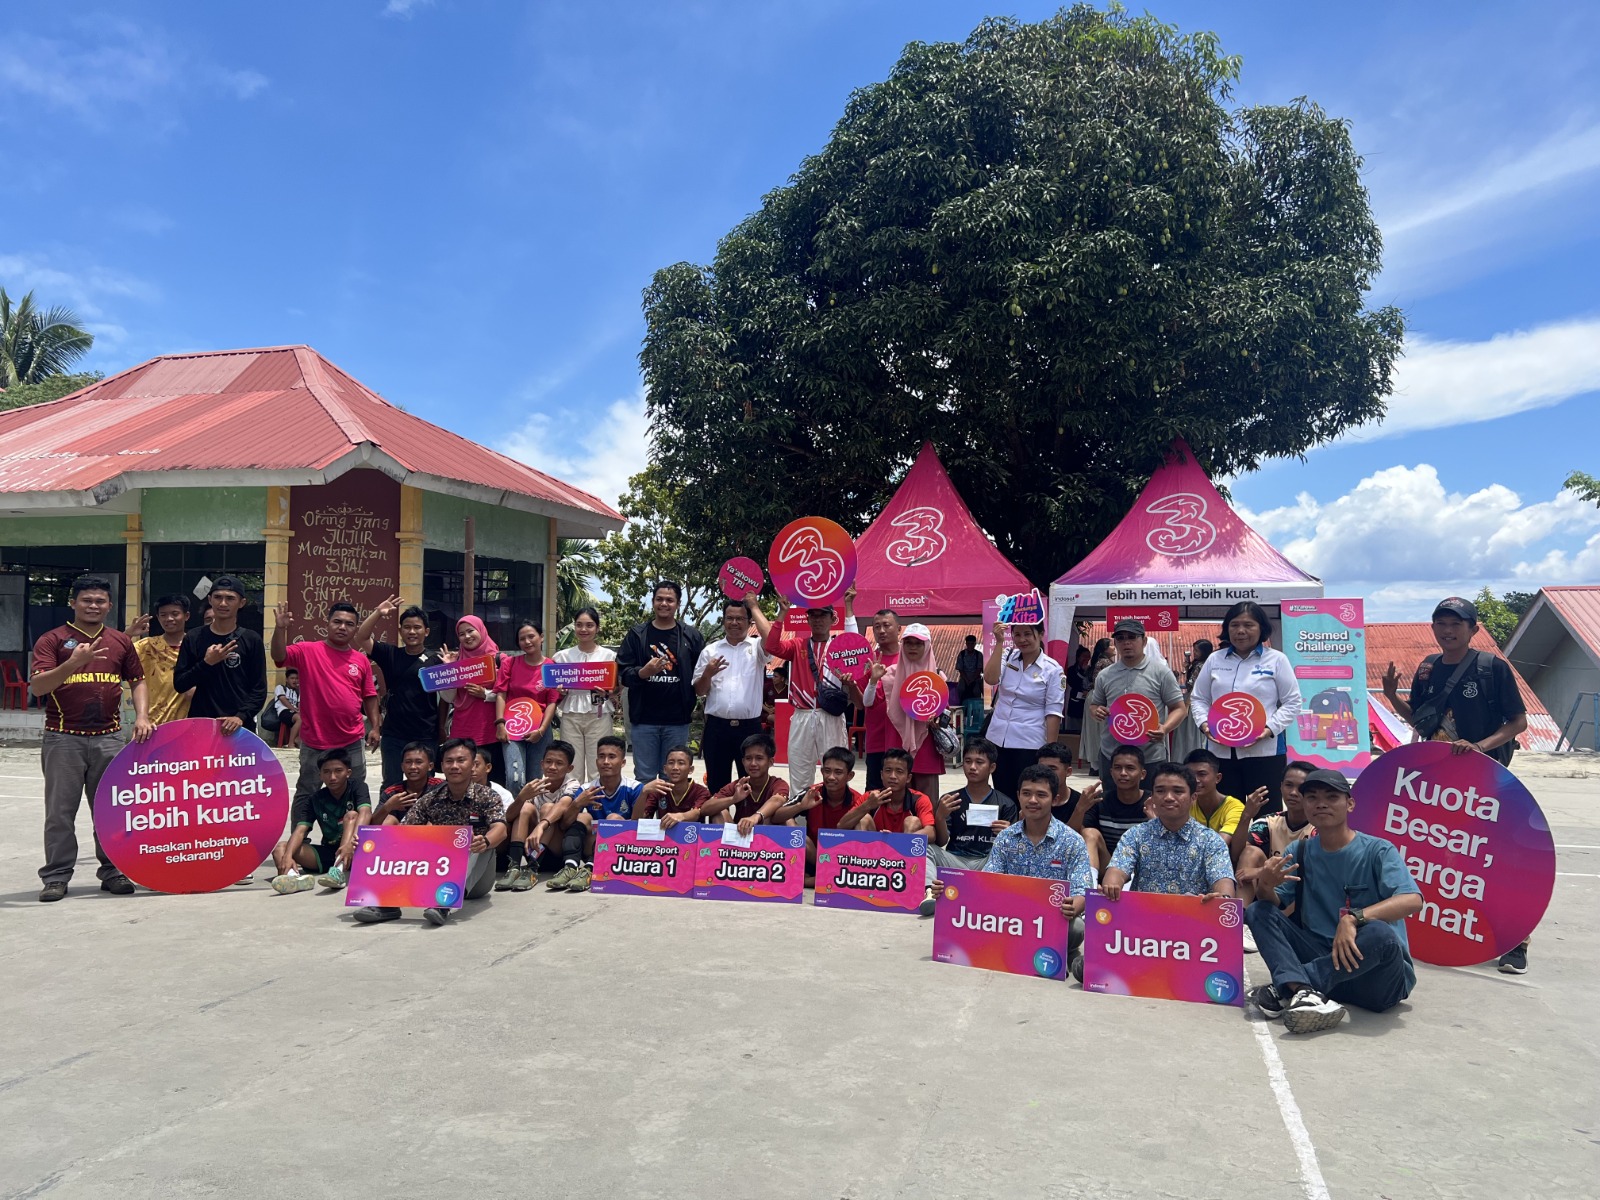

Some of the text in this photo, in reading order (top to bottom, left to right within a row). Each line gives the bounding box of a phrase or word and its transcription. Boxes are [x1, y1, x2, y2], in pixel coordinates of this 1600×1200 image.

[302, 511, 390, 530] Orang yang
[322, 528, 378, 546] JUJUR
[298, 541, 386, 560] Mendapatkan
[326, 558, 340, 573] 3
[302, 570, 394, 593] Kepercayaan,
[726, 564, 759, 588] Ya'ahowu
[732, 576, 745, 589] TRI
[301, 587, 352, 602] CINTA,
[889, 595, 925, 604] indosat
[1106, 588, 1258, 601] lebih hemat, lebih kuat.
[1012, 612, 1038, 623] Kita
[1300, 630, 1348, 640] Sosmed
[829, 647, 868, 660] Ya'ahowu
[1294, 641, 1354, 653] Challenge
[440, 668, 458, 676] lebih
[460, 662, 487, 672] hemat,
[843, 657, 857, 666] TRI
[435, 669, 483, 685] sinyal cepat!
[128, 753, 256, 776] Jaringan Tri kini
[112, 774, 272, 806] lebih hemat,
[1394, 766, 1500, 822] Kuota
[126, 801, 260, 832] lebih kuat.
[1384, 802, 1494, 868] Besar,
[139, 836, 249, 854] Rasakan hebatnya
[627, 845, 653, 854] Happy
[655, 846, 678, 855] Sport
[165, 849, 225, 864] sekarang!
[718, 848, 784, 860] Tri Happy Sport
[837, 855, 904, 868] Tri Happy Sport
[366, 856, 450, 876] Juara 3
[612, 857, 675, 874] Juara 1
[716, 862, 783, 880] Juara 2
[835, 869, 904, 889] Juara 3
[952, 906, 1043, 938] Juara 1
[1105, 930, 1218, 962] Juara 2
[1042, 962, 1047, 971] 1
[1216, 987, 1221, 997] 1
